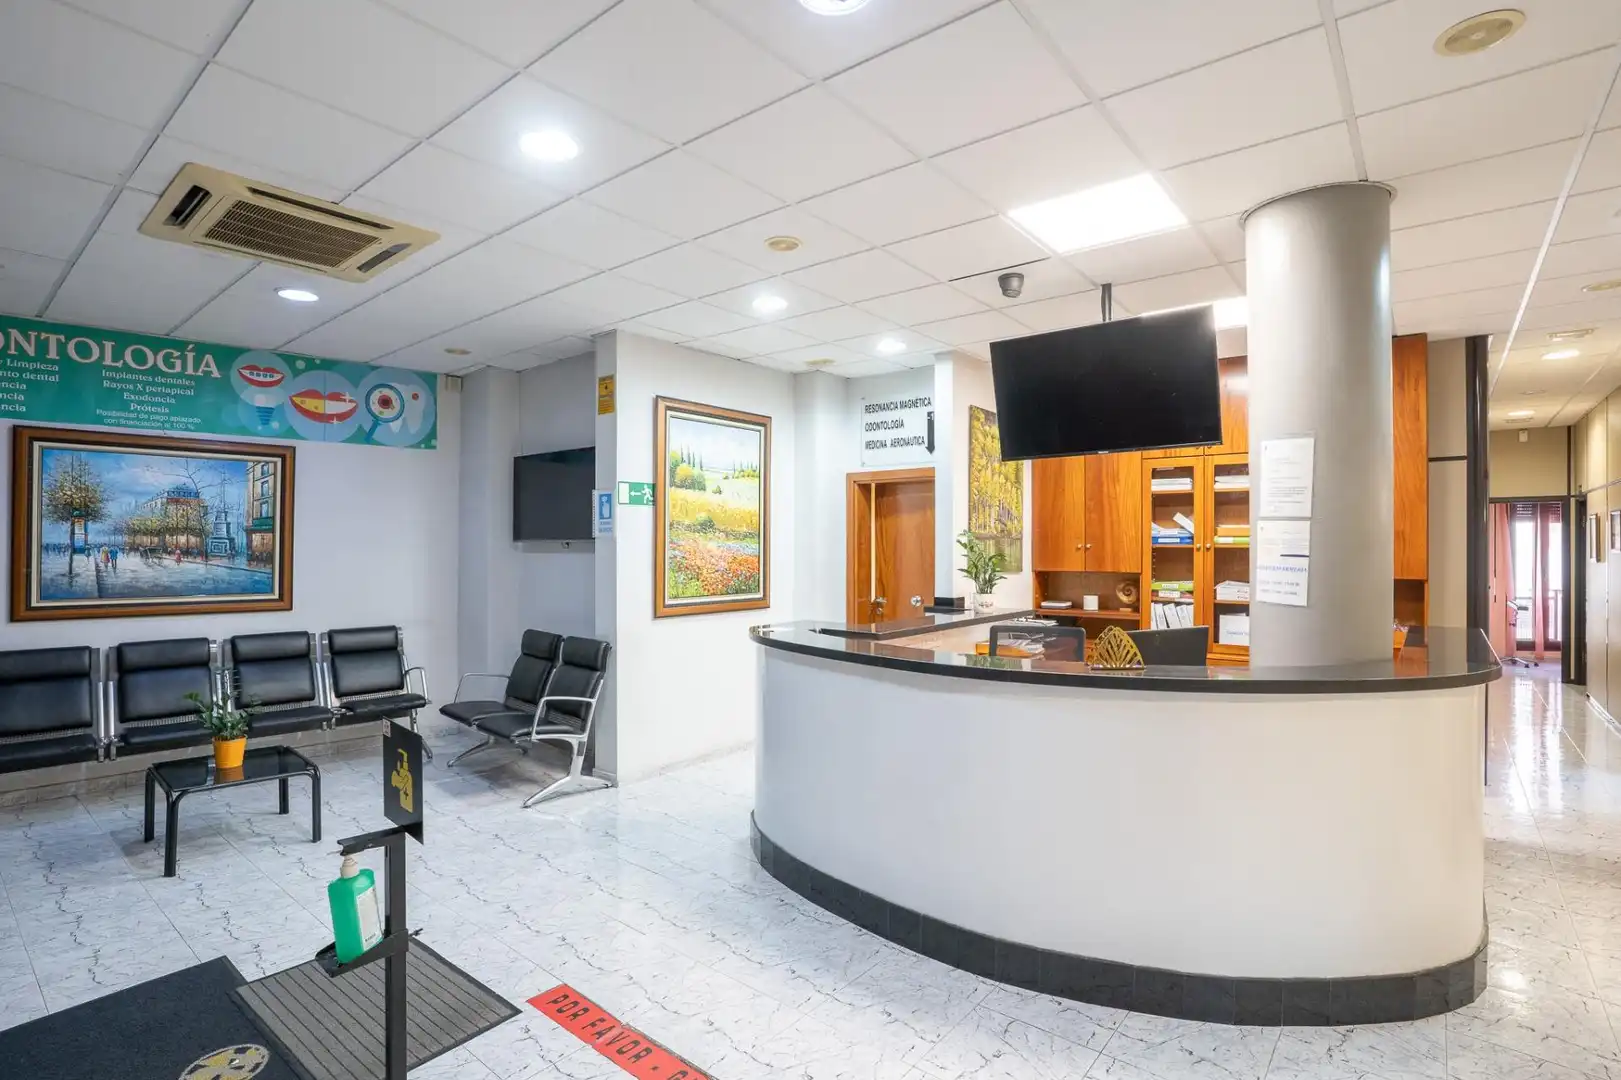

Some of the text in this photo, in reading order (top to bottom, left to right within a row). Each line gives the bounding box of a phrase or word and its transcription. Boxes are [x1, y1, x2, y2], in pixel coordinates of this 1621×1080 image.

[6, 358, 59, 372] Limpieza
[22, 371, 60, 382] dental
[102, 369, 196, 386] Implantes dentales
[102, 379, 194, 396] Rayos X periapical
[123, 391, 176, 404] Exodoncia
[130, 402, 170, 413] Prótesis
[865, 402, 898, 414] RESONANCIA
[119, 418, 163, 428] financiación
[150, 414, 169, 422] pago
[865, 417, 904, 432] ODONTOLOGÍA
[865, 440, 887, 450] MEDICINA
[546, 993, 591, 1022] POR
[582, 1017, 654, 1064] FAVOR
